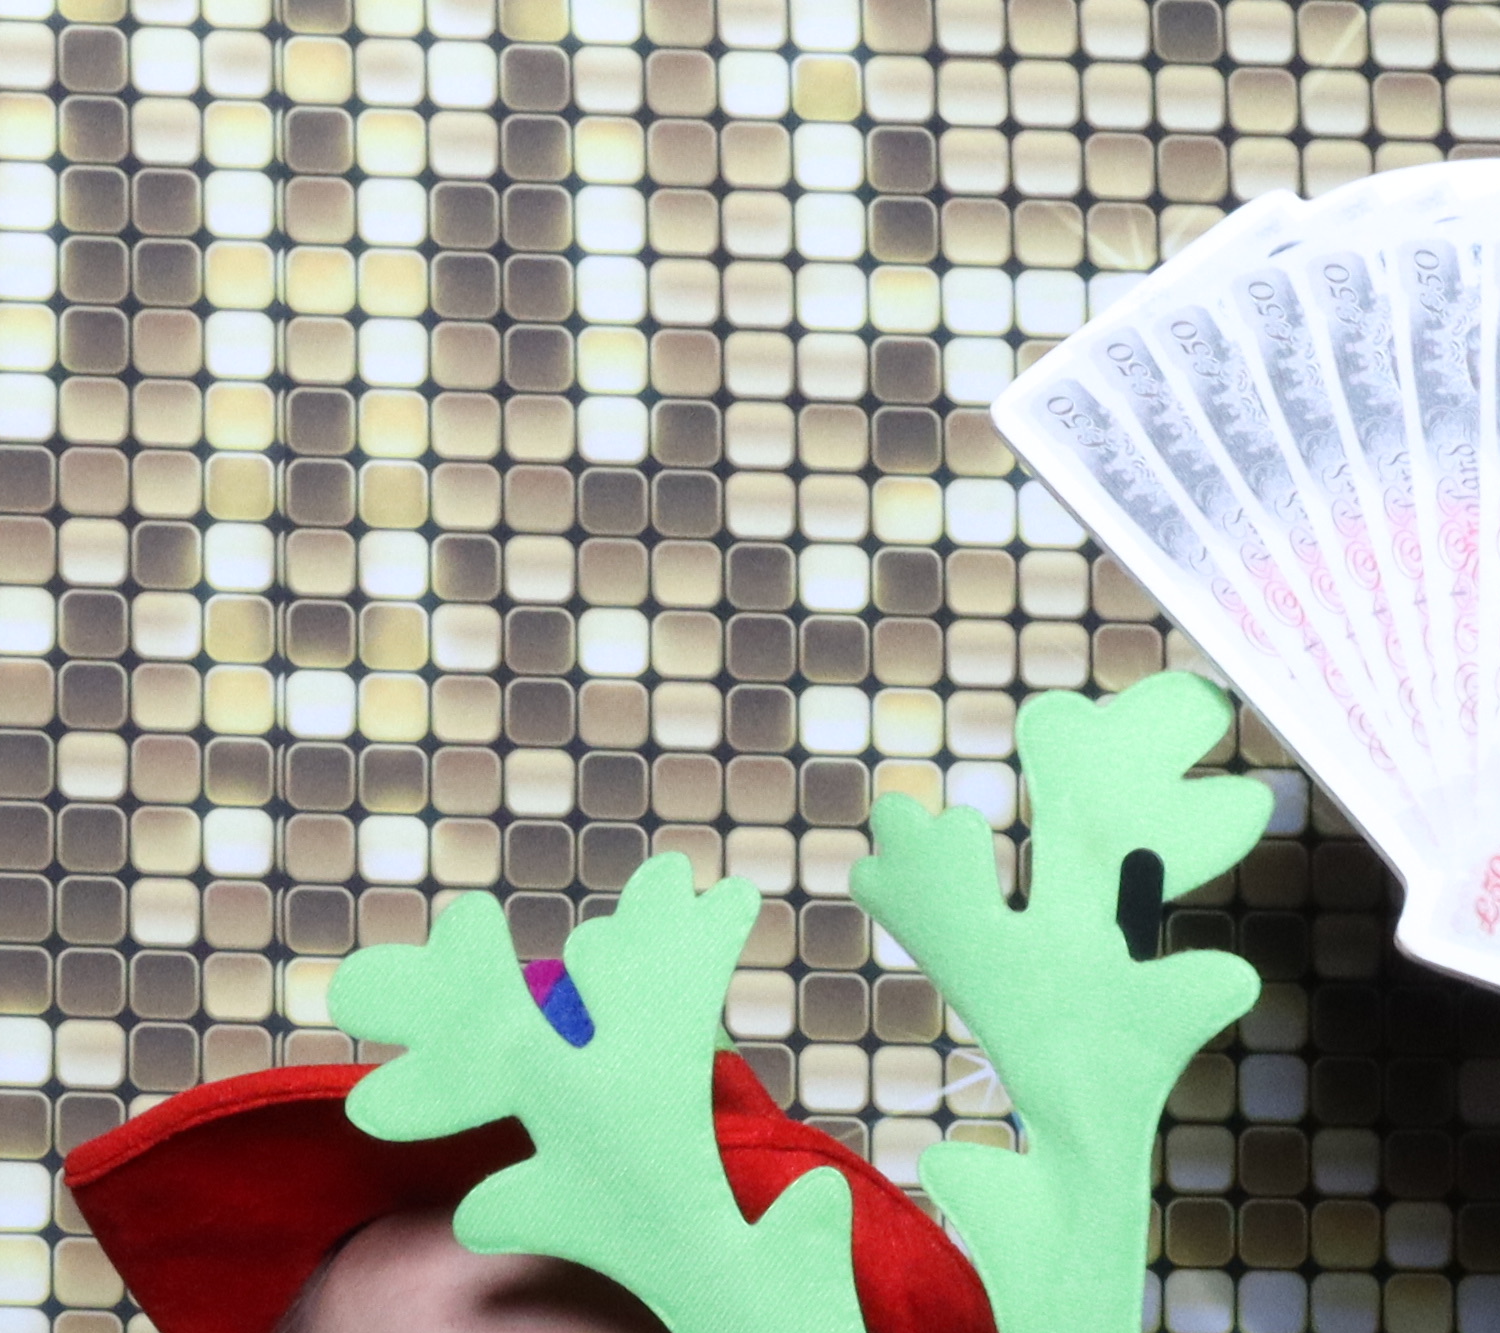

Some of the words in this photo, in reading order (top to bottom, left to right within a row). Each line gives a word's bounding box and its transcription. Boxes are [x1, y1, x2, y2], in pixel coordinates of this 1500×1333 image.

[1248, 281, 1294, 343] £50
[1323, 263, 1363, 329] £50
[1414, 249, 1448, 318] £50
[1106, 342, 1165, 411] £50
[1170, 319, 1224, 384] £50
[1047, 395, 1114, 450] £50
